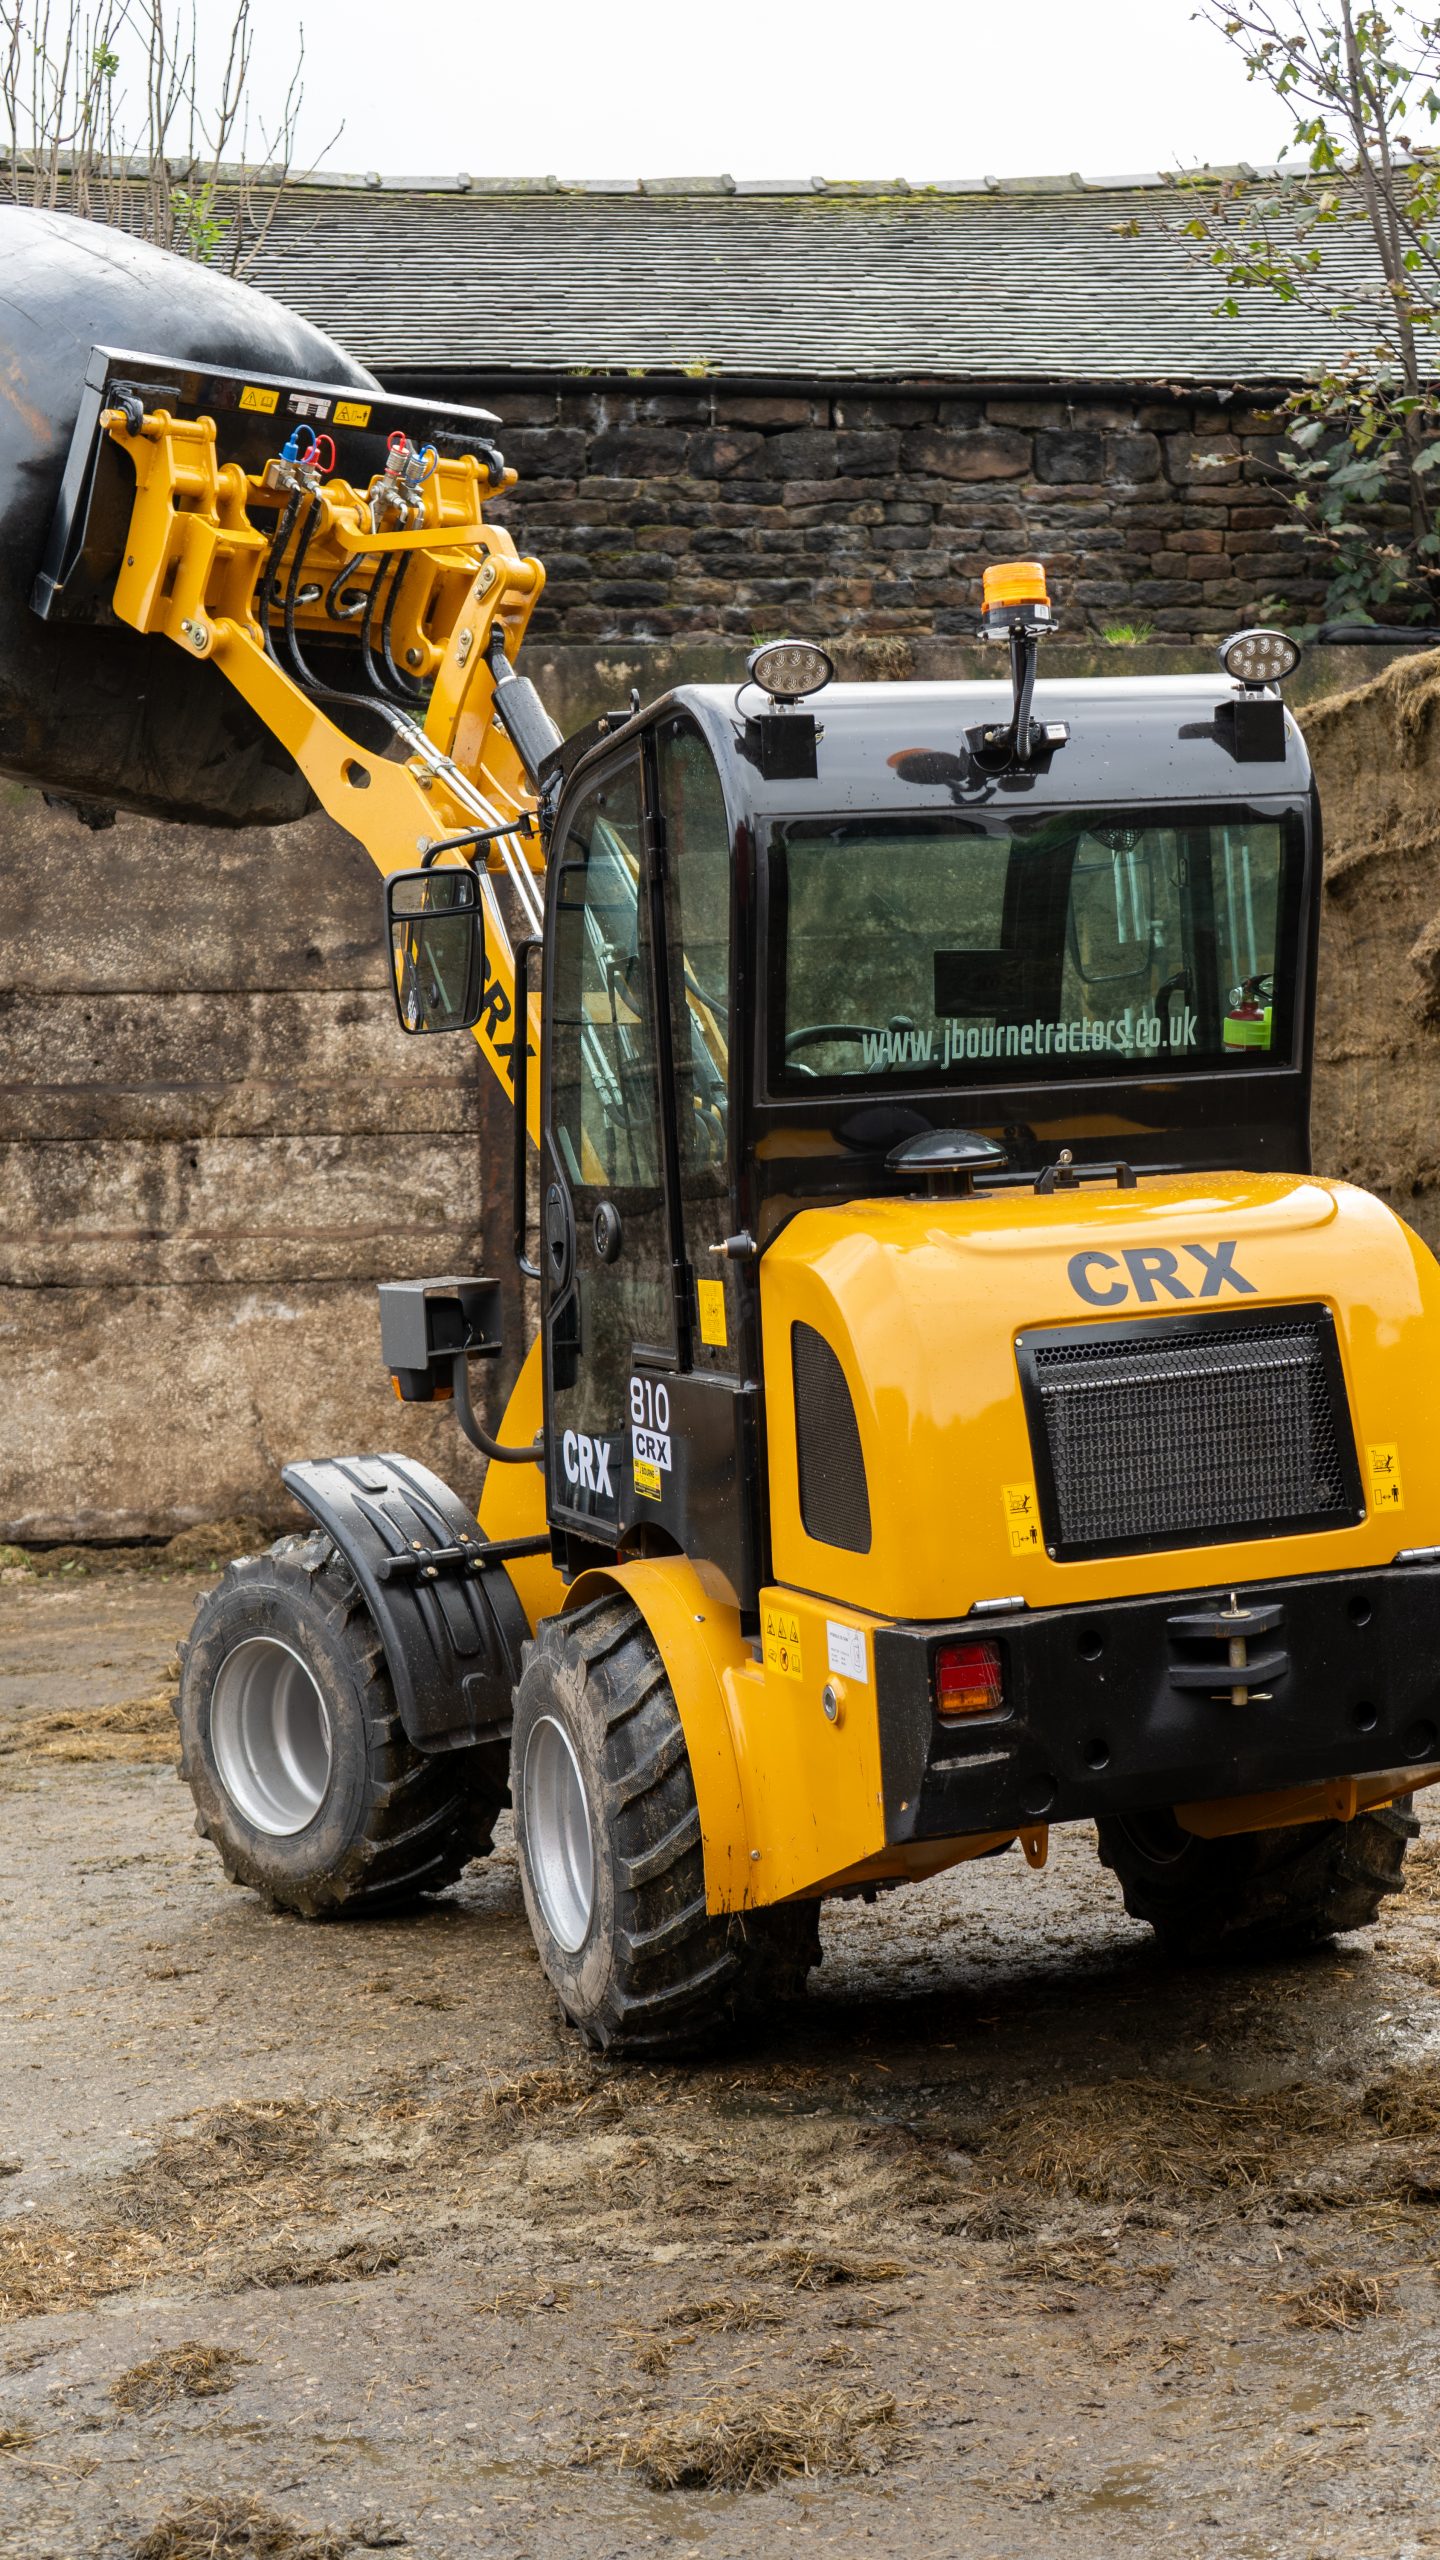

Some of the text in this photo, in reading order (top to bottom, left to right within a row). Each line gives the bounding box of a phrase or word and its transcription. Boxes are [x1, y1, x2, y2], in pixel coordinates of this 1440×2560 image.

[484, 954, 537, 1085] RX
[861, 1005, 1198, 1070] www.jbournetractors.co.uk
[1067, 1240, 1259, 1306] CRX
[629, 1376, 670, 1432] 810
[562, 1429, 614, 1498] CRX
[635, 1432, 668, 1465] CRX
